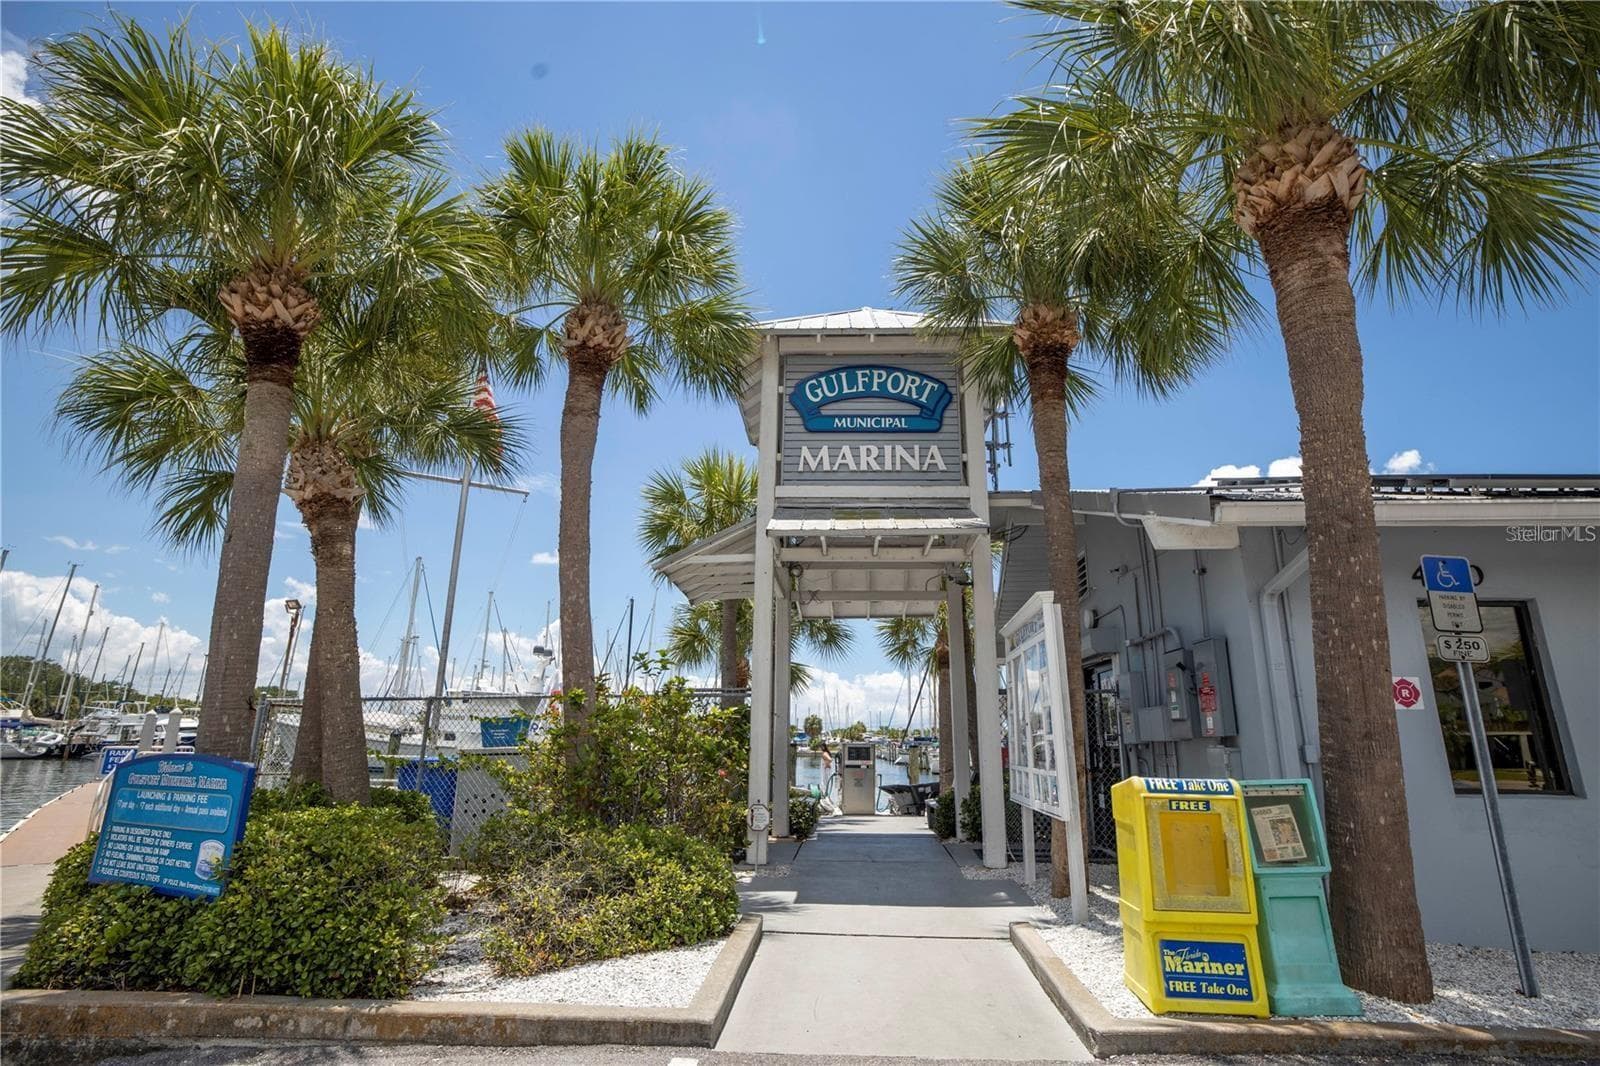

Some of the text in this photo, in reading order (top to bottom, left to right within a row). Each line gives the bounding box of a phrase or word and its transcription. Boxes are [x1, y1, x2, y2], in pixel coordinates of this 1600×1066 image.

[805, 370, 938, 403] GULFPORT
[833, 417, 908, 428] MUNICIPAL
[798, 444, 947, 472] MARINA
[1444, 640, 1480, 651] $ 250
[1453, 650, 1473, 658] FINE
[1401, 689, 1411, 698] R
[1148, 778, 1229, 792] FREE Take One
[137, 792, 166, 801] LAUNCHING
[173, 794, 196, 803] PARKING
[198, 795, 208, 804] FEE
[1171, 801, 1207, 810] FREE
[1163, 954, 1245, 976] Mariner
[1168, 980, 1249, 996] FREE Take One
